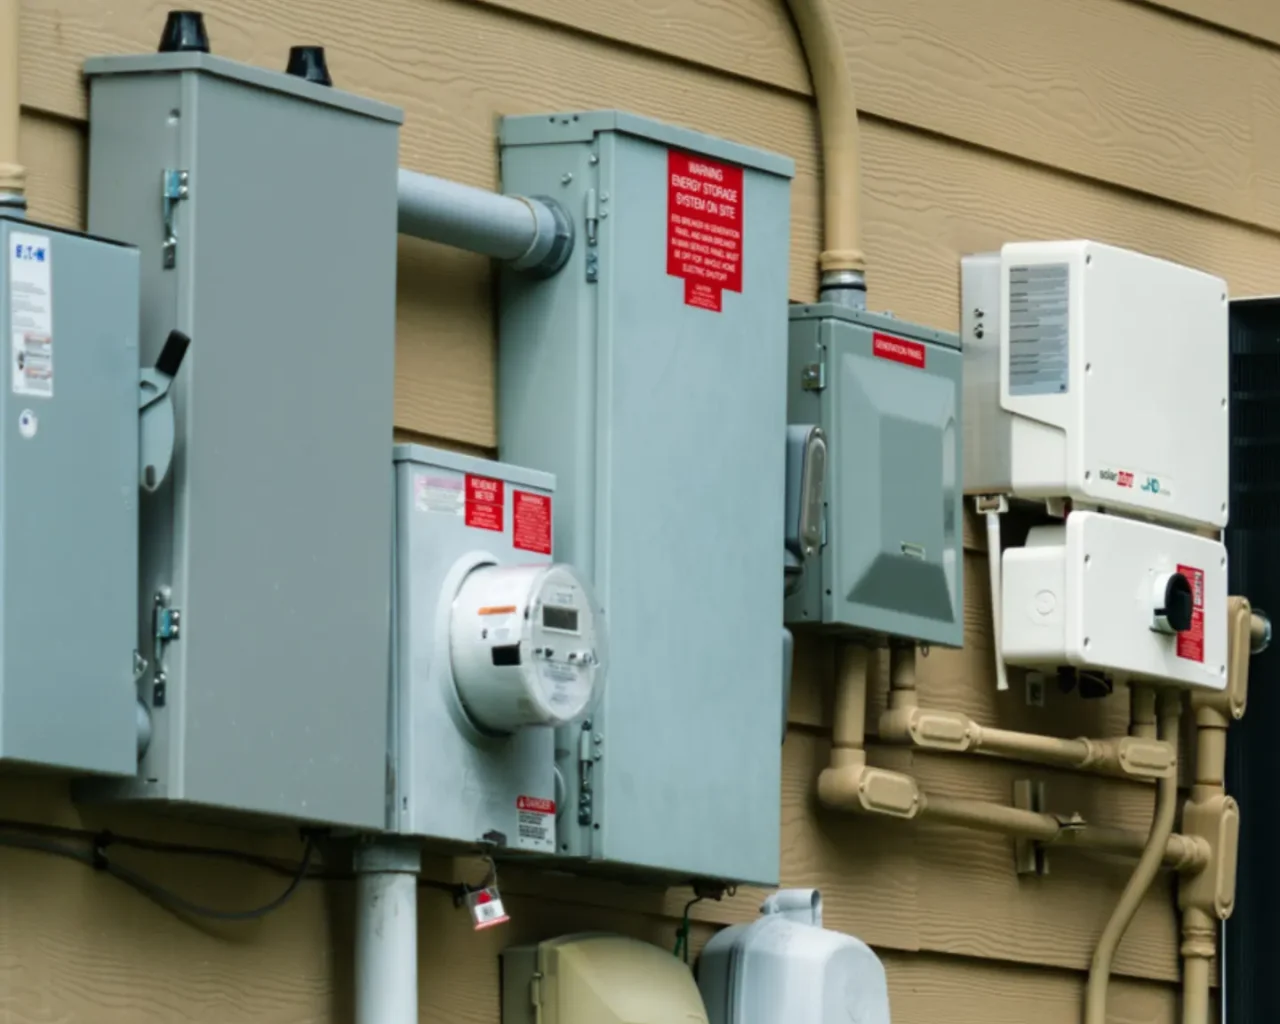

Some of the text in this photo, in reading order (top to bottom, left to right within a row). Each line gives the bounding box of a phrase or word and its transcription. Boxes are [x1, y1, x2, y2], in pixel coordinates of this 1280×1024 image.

[688, 161, 723, 181] WARNING
[672, 174, 737, 203] ENERGY STORAGE
[676, 192, 735, 219] SYSTEM ON SITE
[474, 490, 495, 501] METER
